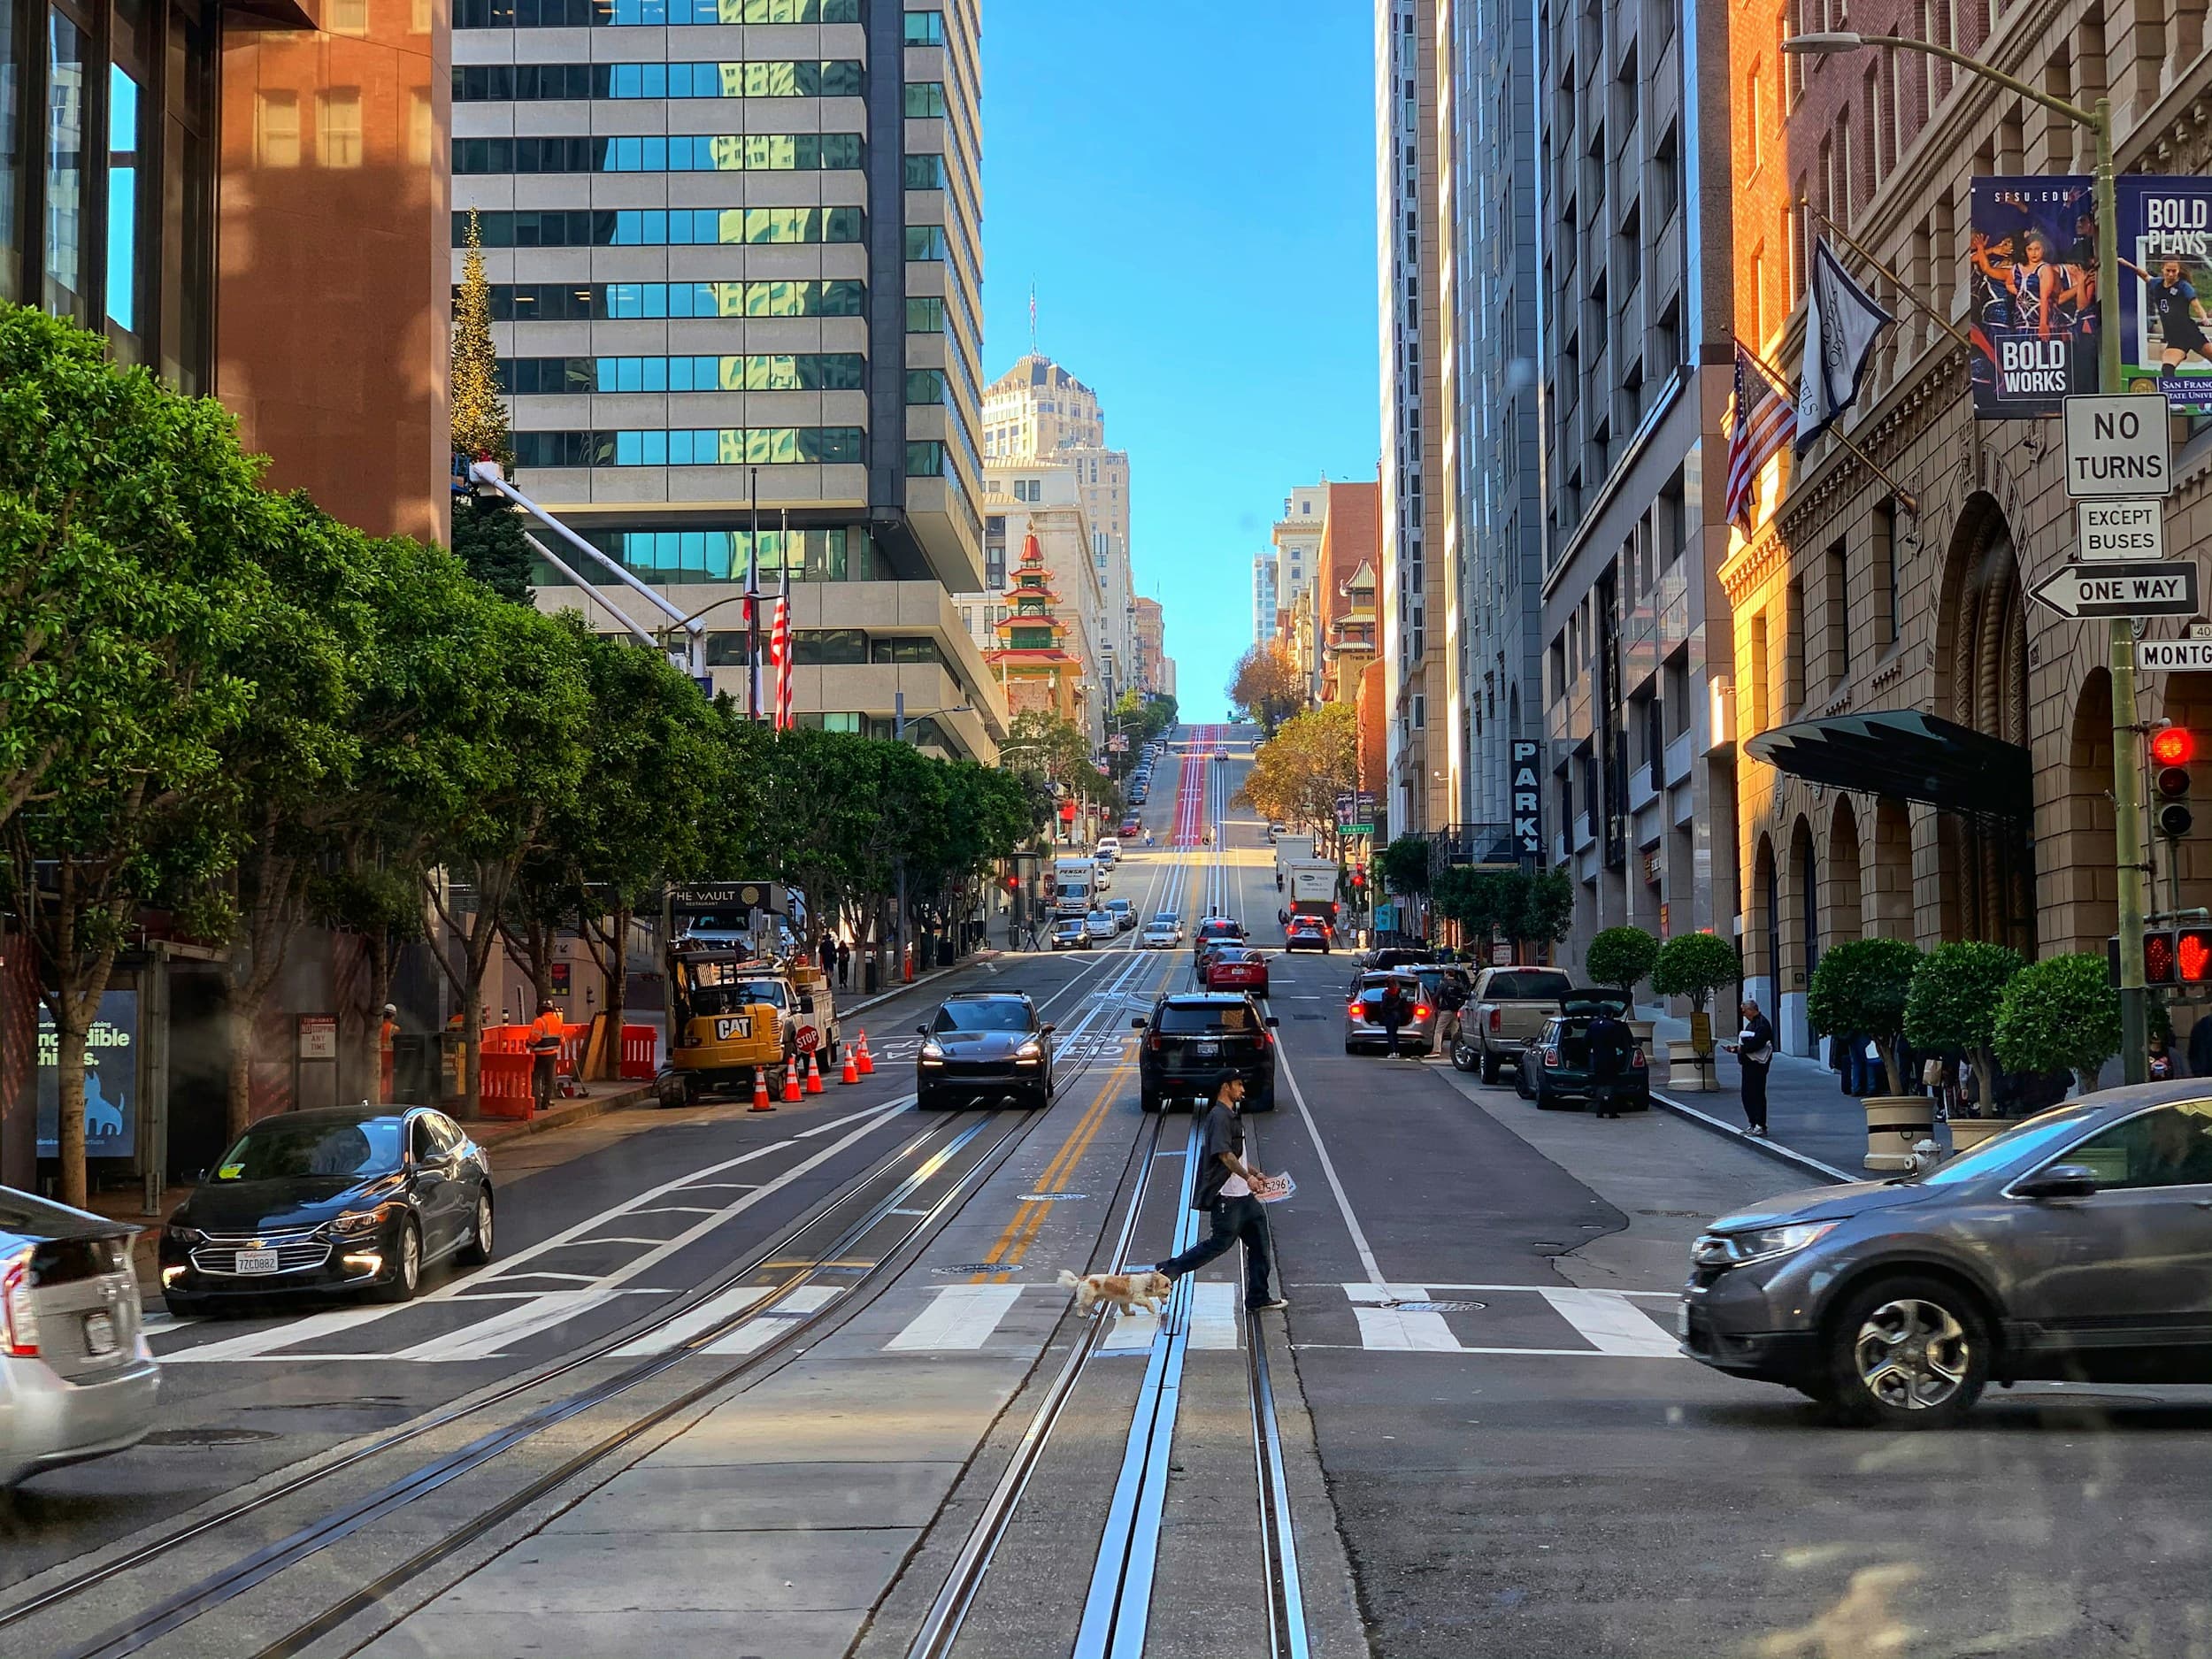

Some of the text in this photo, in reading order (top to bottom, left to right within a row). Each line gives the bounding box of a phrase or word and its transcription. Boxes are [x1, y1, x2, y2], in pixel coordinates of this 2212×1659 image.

[1994, 191, 2070, 203] SFSU.EDU
[2147, 198, 2208, 228] BOLD
[2147, 230, 2208, 255] PLAYS
[2002, 341, 2066, 371] BOLD
[2003, 371, 2067, 393] WORKS
[2094, 411, 2139, 440] NO
[2075, 455, 2162, 480] TURNS
[2088, 510, 2153, 526] EXCEPT
[2089, 534, 2154, 549] BUSES
[2079, 579, 2179, 601] ONE WAY
[2145, 645, 2212, 664] MONTG
[1515, 742, 1539, 836] PARK
[696, 891, 735, 901] VAULT
[718, 1018, 749, 1039] CAT
[796, 1030, 818, 1048] STOP
